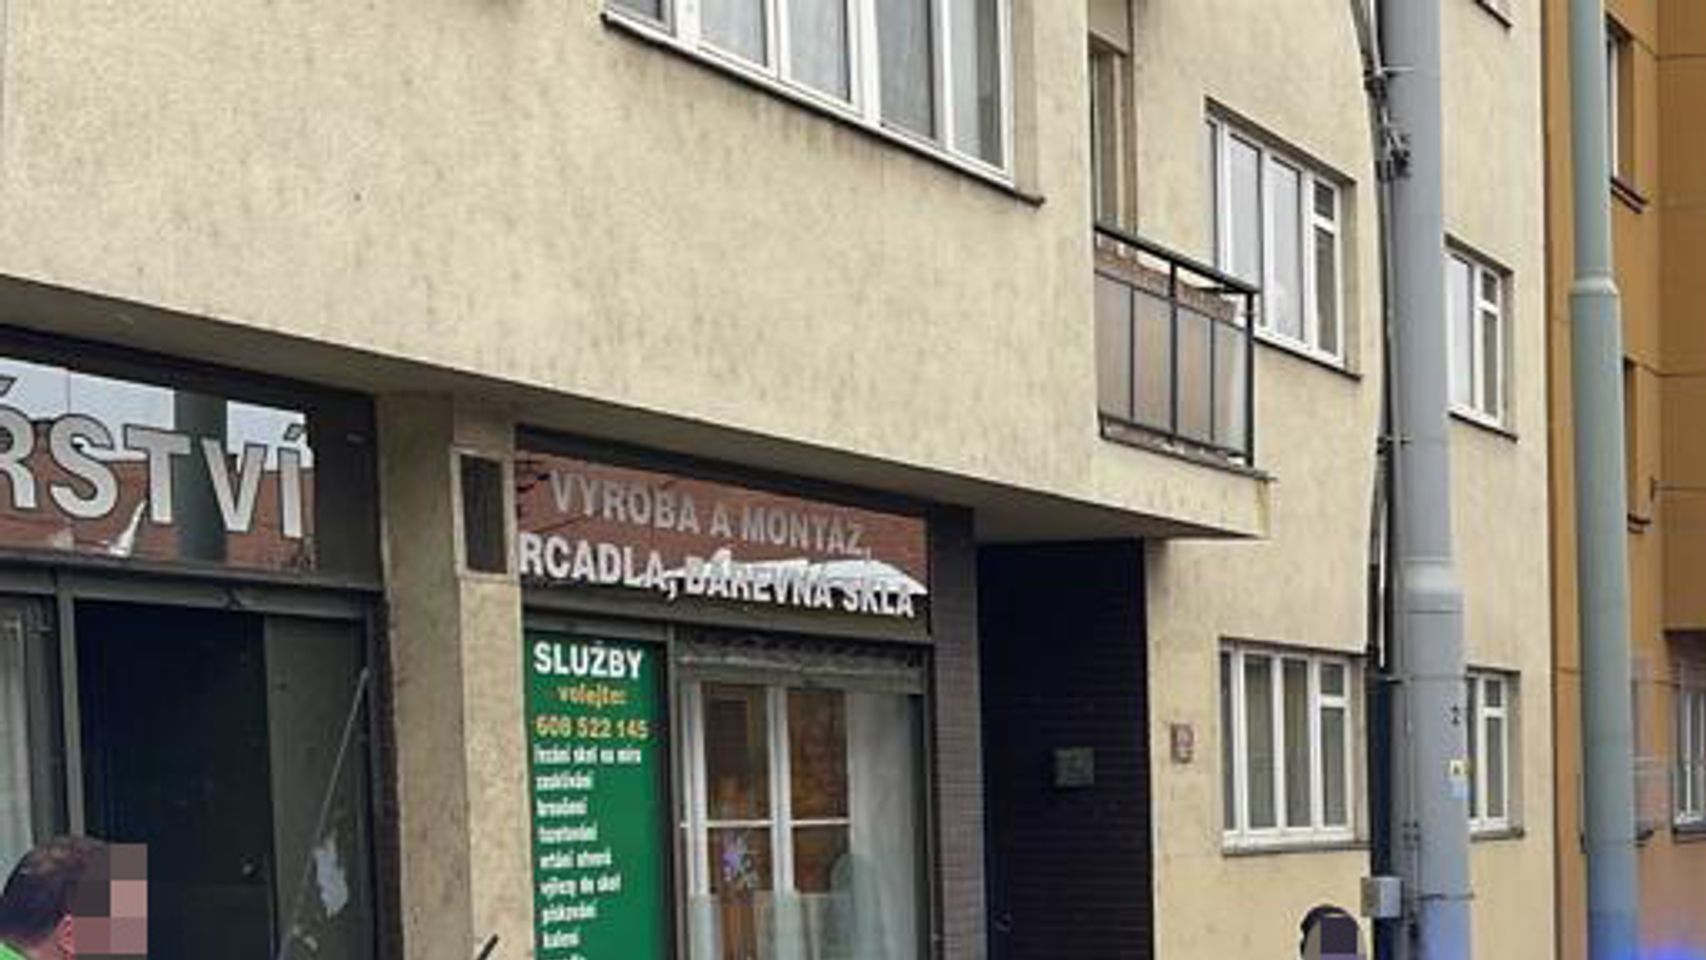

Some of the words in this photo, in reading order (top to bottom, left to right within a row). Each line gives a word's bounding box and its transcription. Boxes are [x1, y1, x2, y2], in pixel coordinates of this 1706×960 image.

[709, 501, 733, 538] A
[533, 640, 644, 679] SLUŽBY
[577, 716, 612, 740] 522
[616, 718, 649, 741] 145
